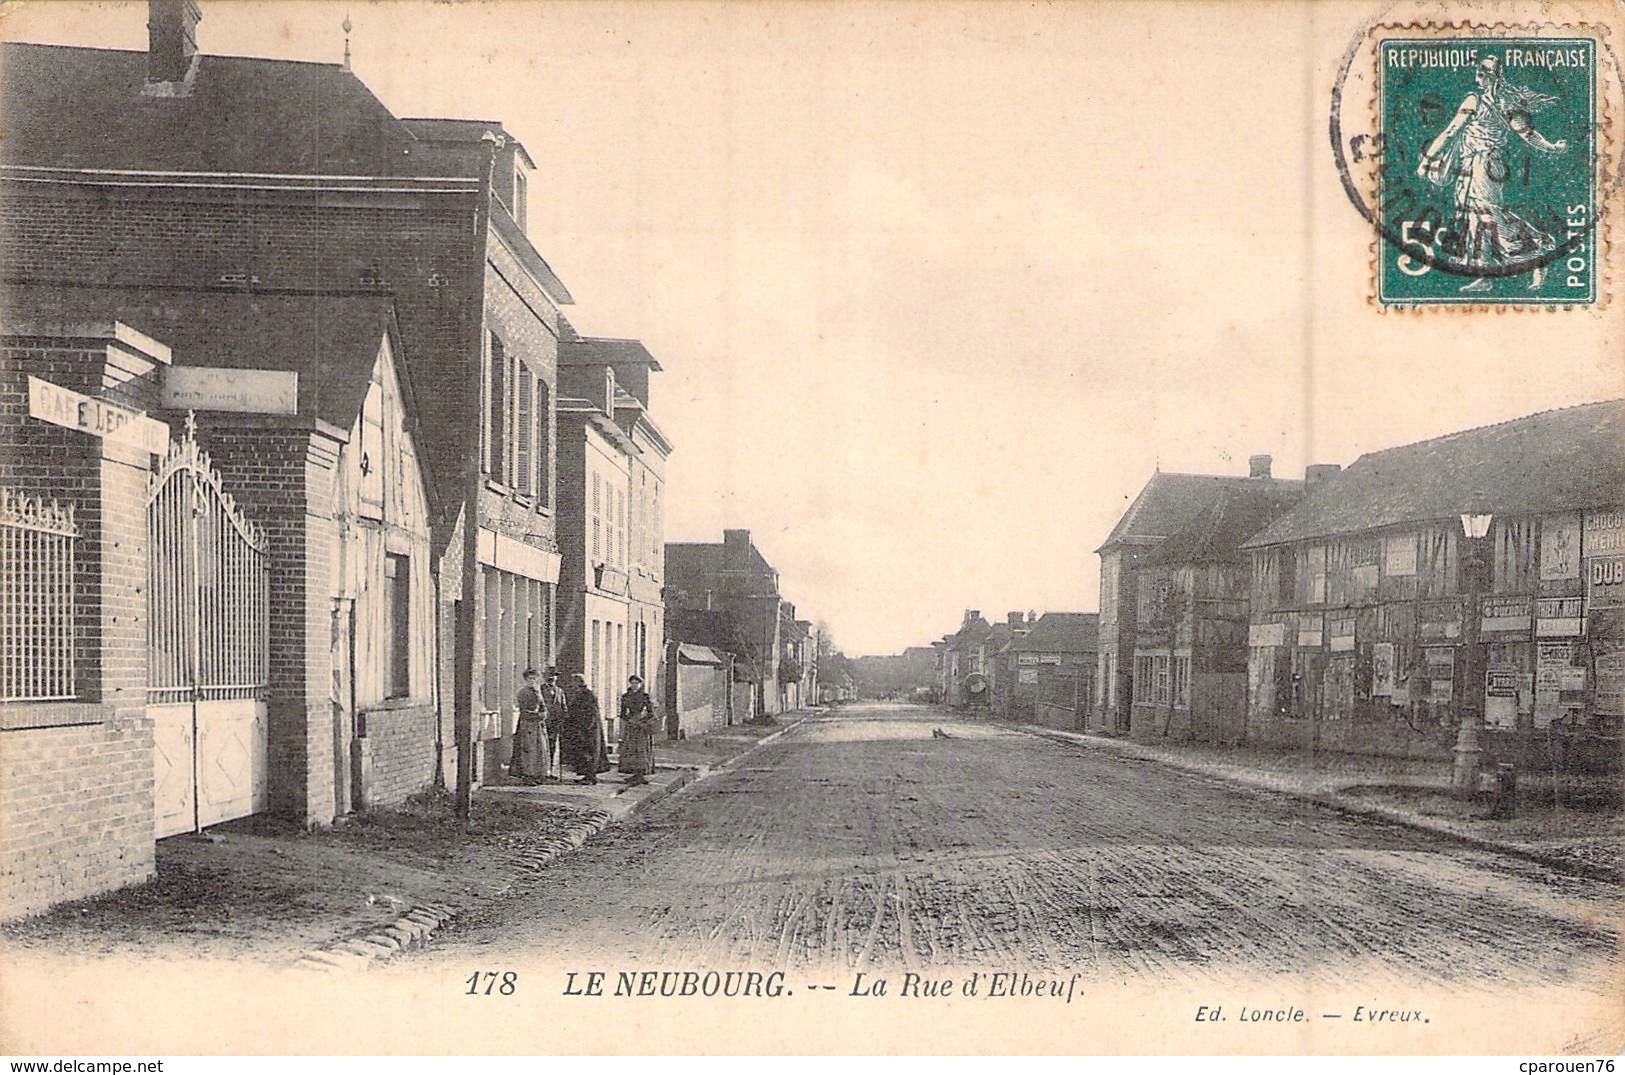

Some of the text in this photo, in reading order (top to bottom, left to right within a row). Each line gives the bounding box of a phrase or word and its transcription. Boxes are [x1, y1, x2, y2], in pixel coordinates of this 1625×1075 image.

[1505, 49, 1586, 71] FRANÇAISE
[1566, 204, 1587, 288] POSTES
[466, 972, 517, 996] 178
[562, 972, 604, 997] LE
[614, 972, 794, 997] NEUBOURG.
[849, 972, 887, 997] La
[901, 972, 953, 998] Rue
[962, 973, 1084, 1004] d'Elbeuf.
[1196, 1006, 1226, 1022] Ed.
[1239, 1006, 1309, 1022] Loncle.
[1353, 1006, 1430, 1024] Evreux.
